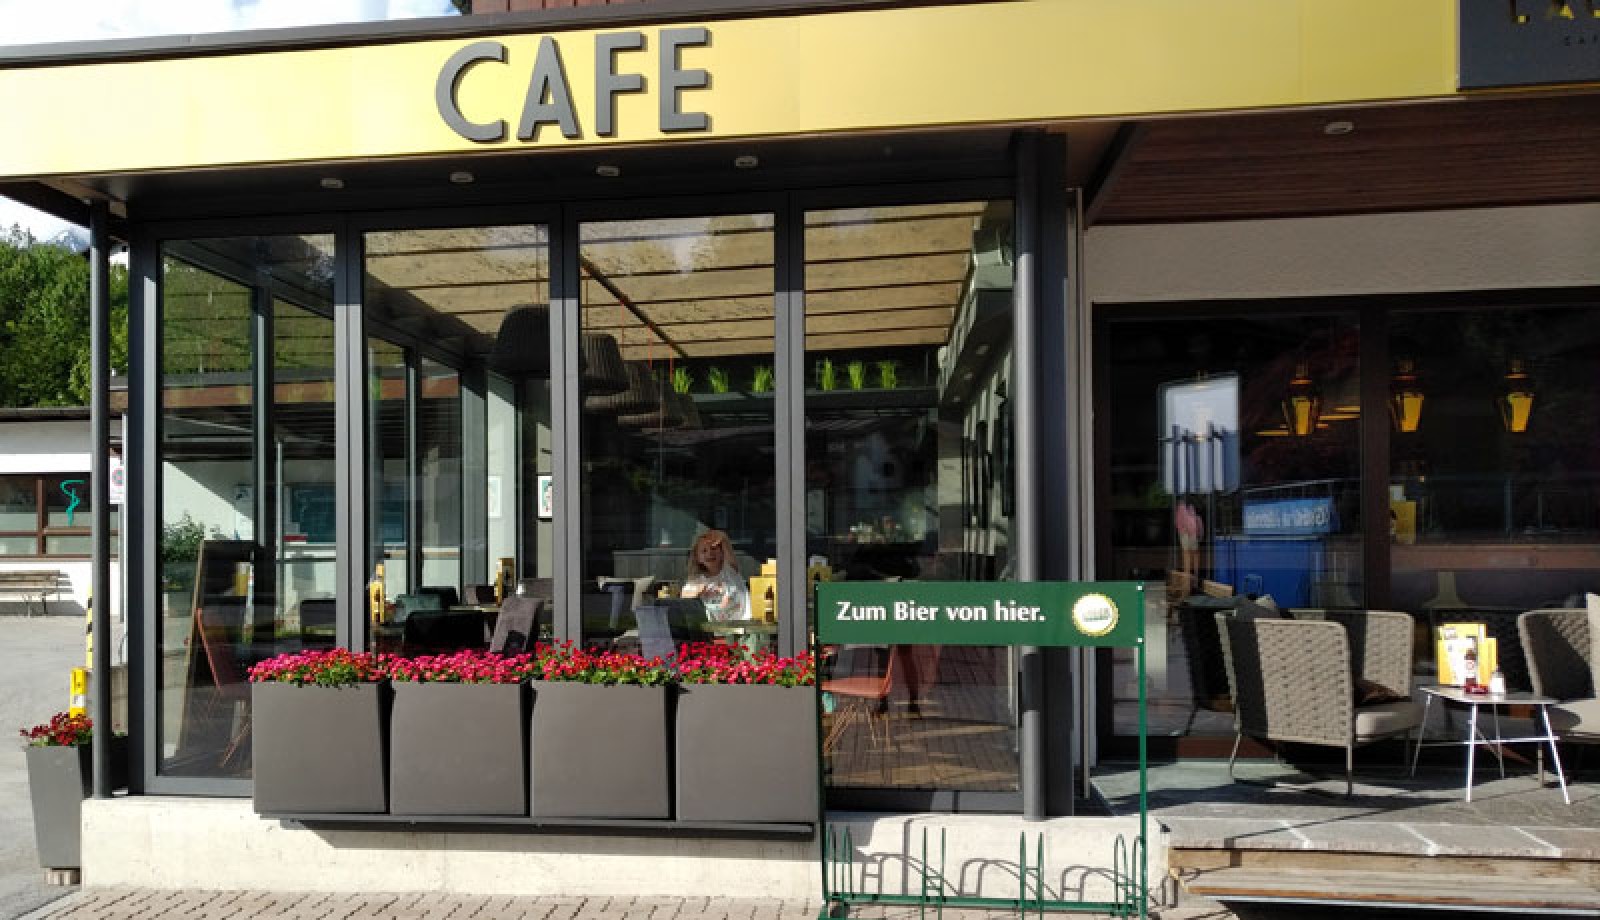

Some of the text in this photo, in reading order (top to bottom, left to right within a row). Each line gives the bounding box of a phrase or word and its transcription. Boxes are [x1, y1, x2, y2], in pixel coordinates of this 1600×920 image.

[436, 27, 711, 142] CAFE
[835, 599, 1047, 622] Zum Bier von hier.
